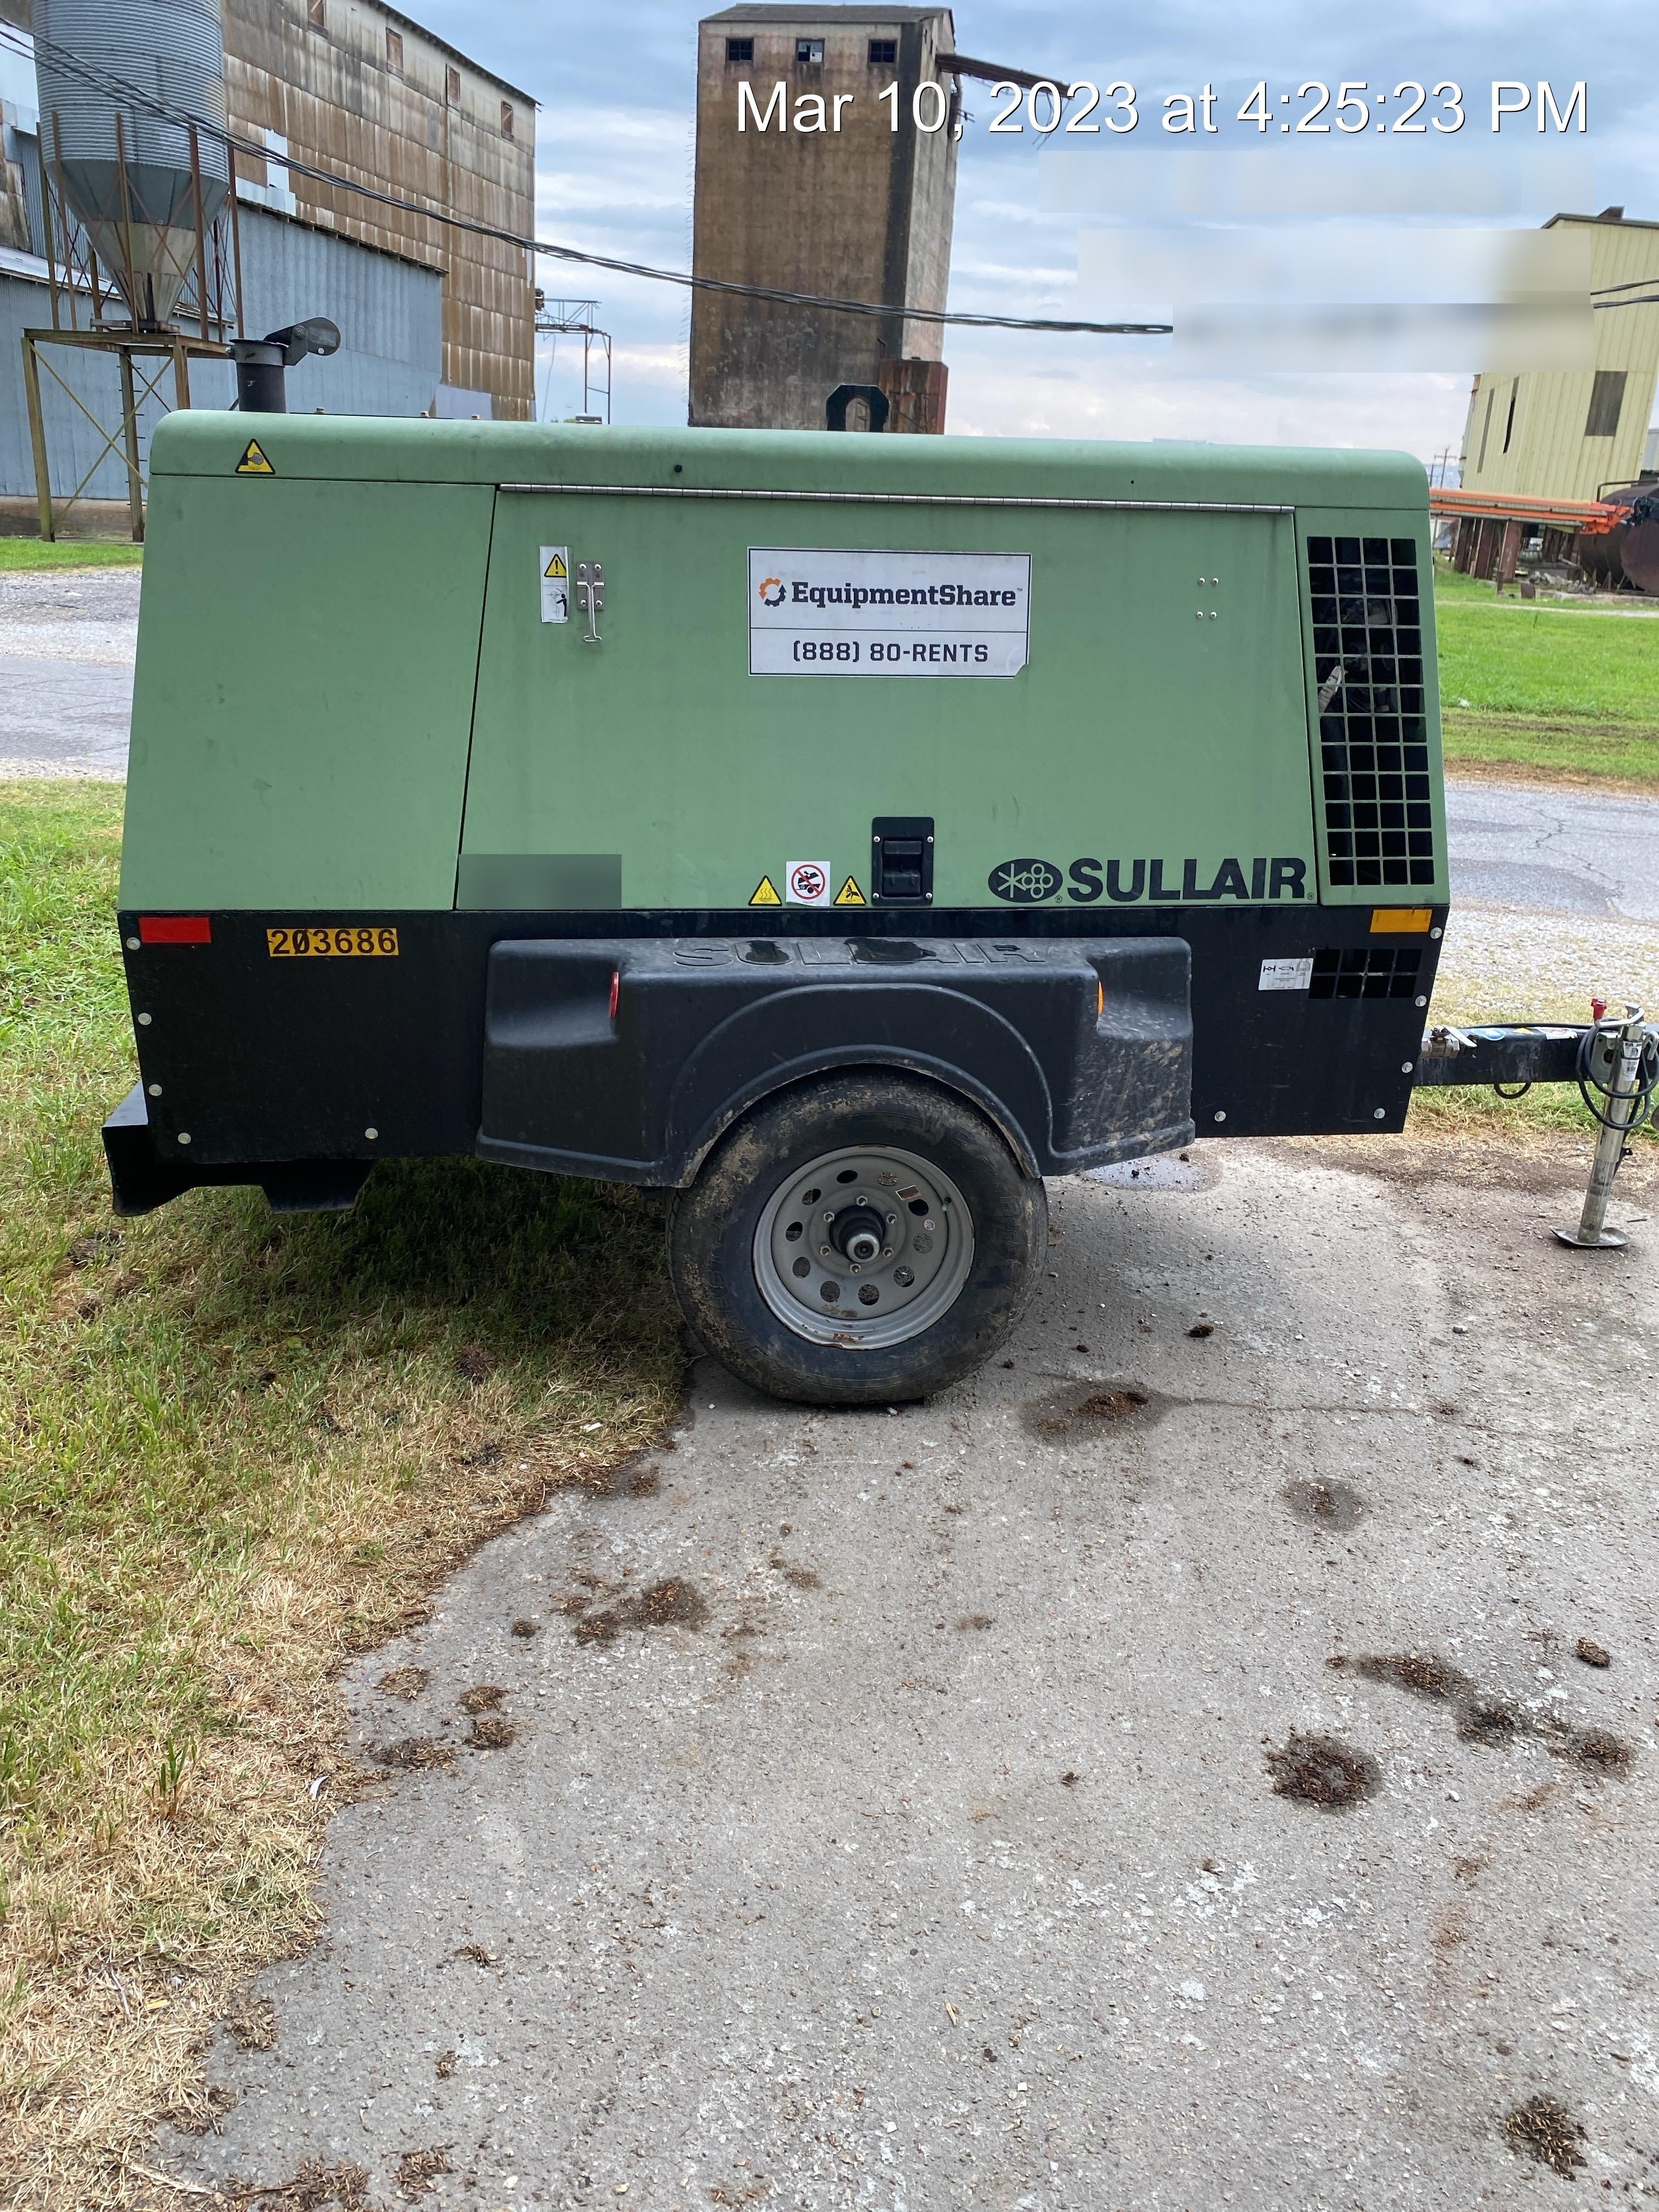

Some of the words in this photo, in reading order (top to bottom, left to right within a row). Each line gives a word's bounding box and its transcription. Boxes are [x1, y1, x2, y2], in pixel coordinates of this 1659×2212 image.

[792, 582, 1016, 609] EquipmentShare
[793, 640, 860, 663] (888)
[870, 643, 988, 663] 80-RENTS
[1067, 857, 1306, 902] SULLAIR
[271, 929, 396, 955] 203686
